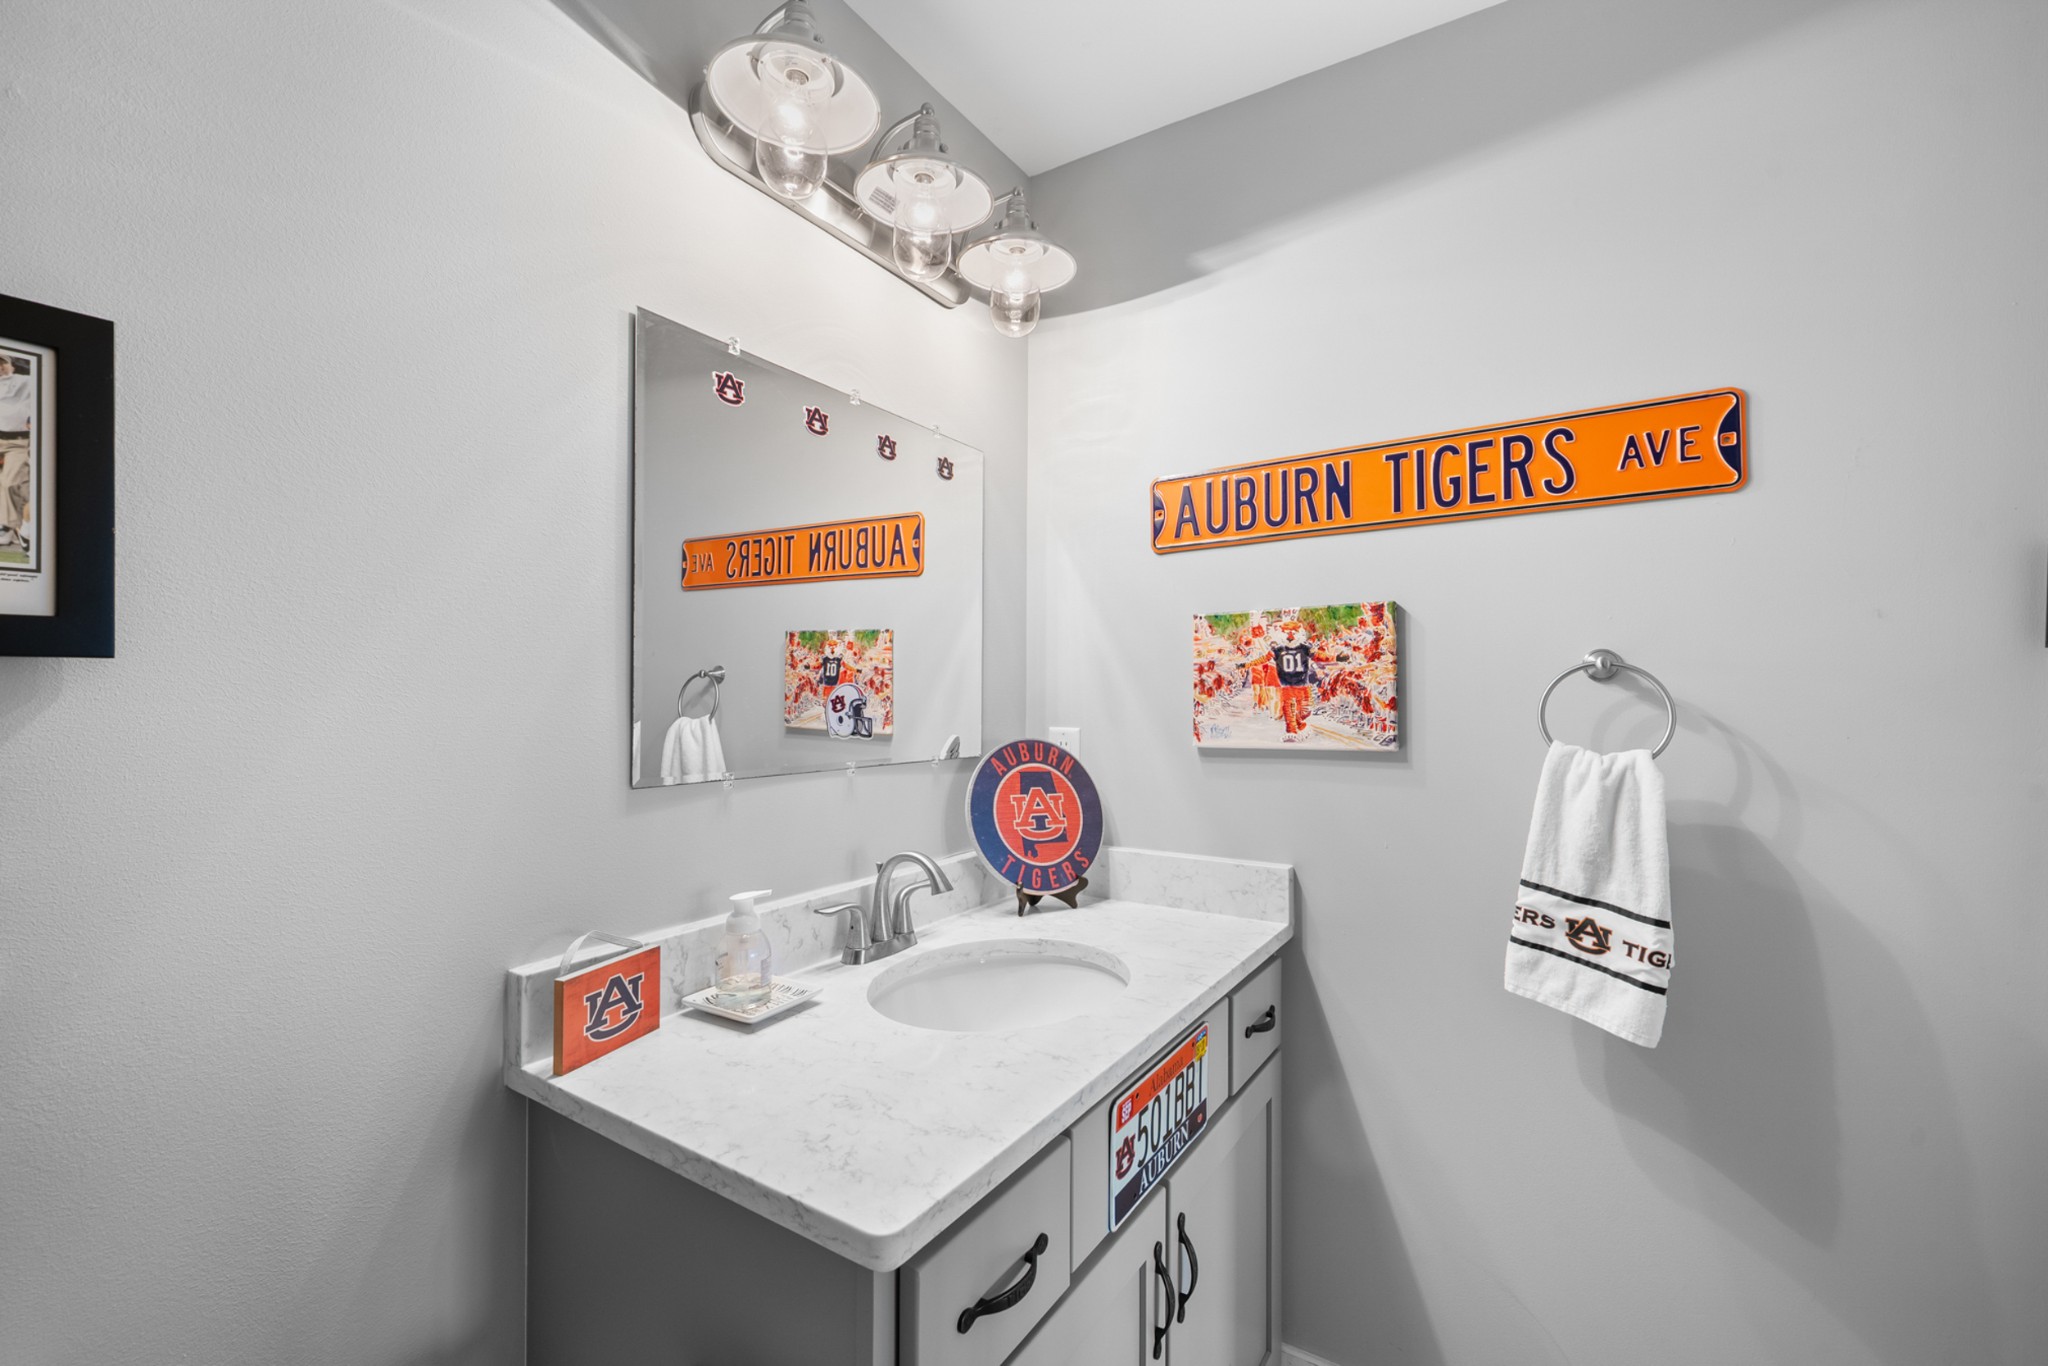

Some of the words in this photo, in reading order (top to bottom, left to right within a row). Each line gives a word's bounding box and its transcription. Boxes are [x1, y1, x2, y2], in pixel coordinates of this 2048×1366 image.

[1173, 460, 1352, 539] AUBURN
[1385, 427, 1576, 514] TIGERS
[1617, 425, 1701, 472] AVE
[1282, 652, 1304, 673] 01
[991, 742, 1074, 776] AUBURN
[1001, 849, 1089, 889] TIGERS
[1149, 1056, 1184, 1096] Alabama
[1139, 1120, 1189, 1195] AUBURN
